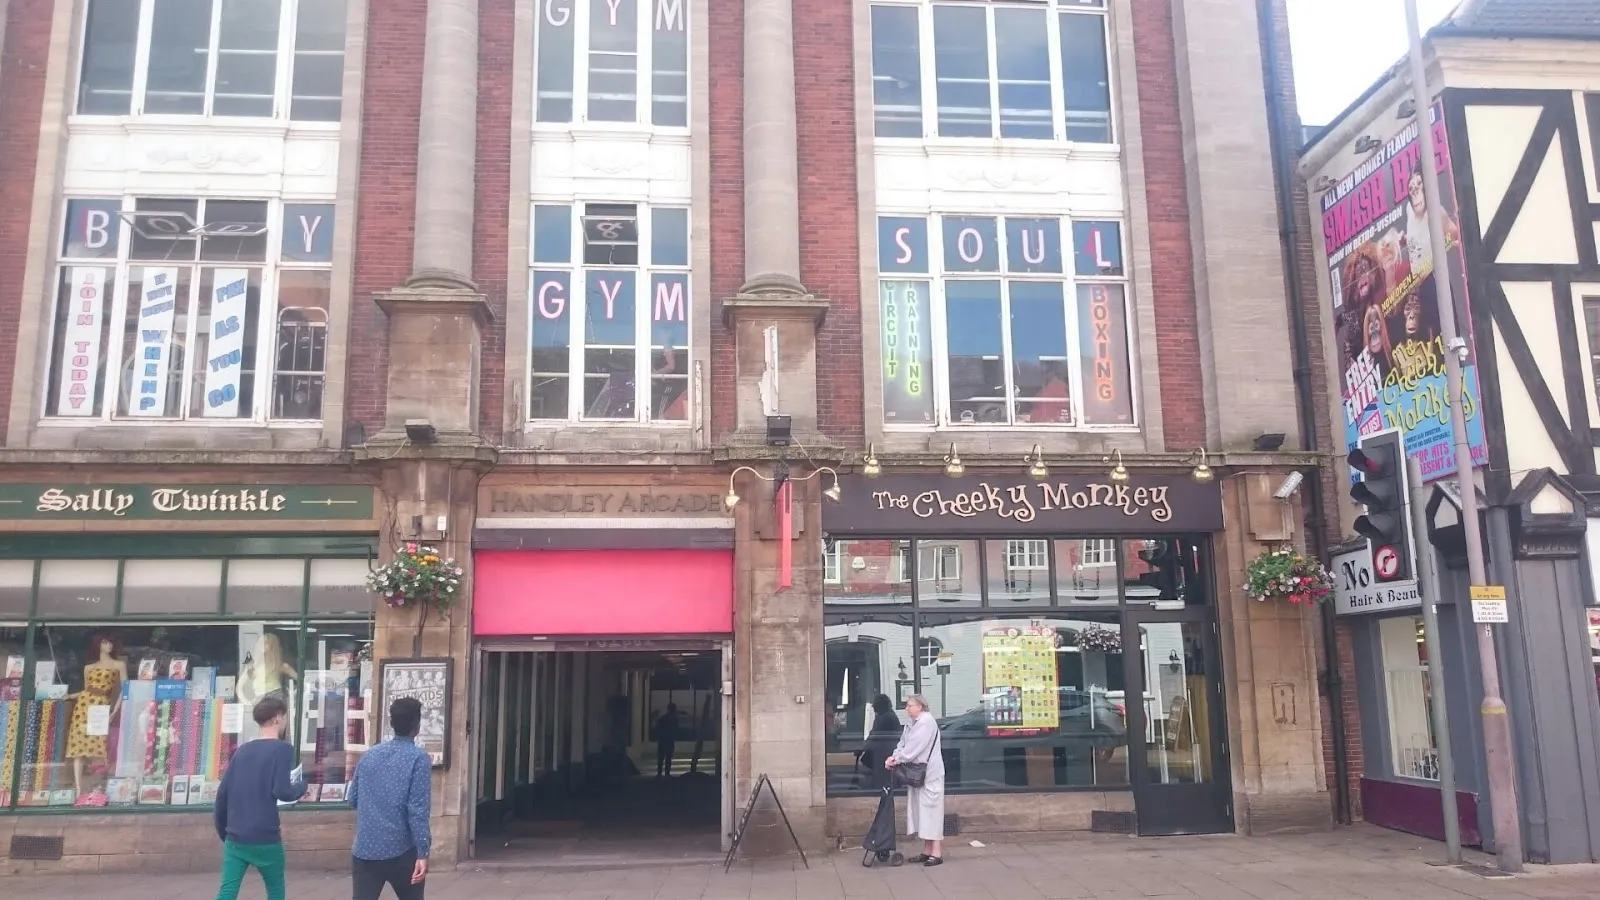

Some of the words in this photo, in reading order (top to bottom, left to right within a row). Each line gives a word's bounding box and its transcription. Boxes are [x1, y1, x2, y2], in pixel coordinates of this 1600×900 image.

[1325, 188, 1337, 210] ALL
[1337, 174, 1354, 201] NEW
[1354, 149, 1386, 187] MONKEY
[1386, 106, 1435, 160] FLAVOUD
[1323, 168, 1388, 254] SMASH
[894, 227, 1111, 267] SOUL
[1329, 248, 1344, 267] NOW
[76, 273, 96, 325] JOIN
[216, 278, 245, 303] PAY
[538, 280, 684, 322] GYM
[215, 316, 240, 340] AS
[1091, 287, 1112, 400] BOXING
[69, 342, 91, 409] TODAY
[209, 349, 241, 372] YOU
[1346, 346, 1375, 396] FREE
[208, 384, 236, 408] GO
[1346, 363, 1382, 425] ENTRY
[36, 488, 134, 516] Sally
[151, 488, 286, 512] Twinkle
[489, 491, 614, 513] HANDLEY
[617, 491, 721, 513] ARCADE
[872, 491, 909, 510] The
[912, 482, 1036, 522] Cheeky
[1037, 482, 1172, 522] Monkey
[1341, 560, 1370, 591] No
[1350, 595, 1373, 607] Hair
[1376, 592, 1384, 604] &
[1388, 589, 1417, 603] Beau
